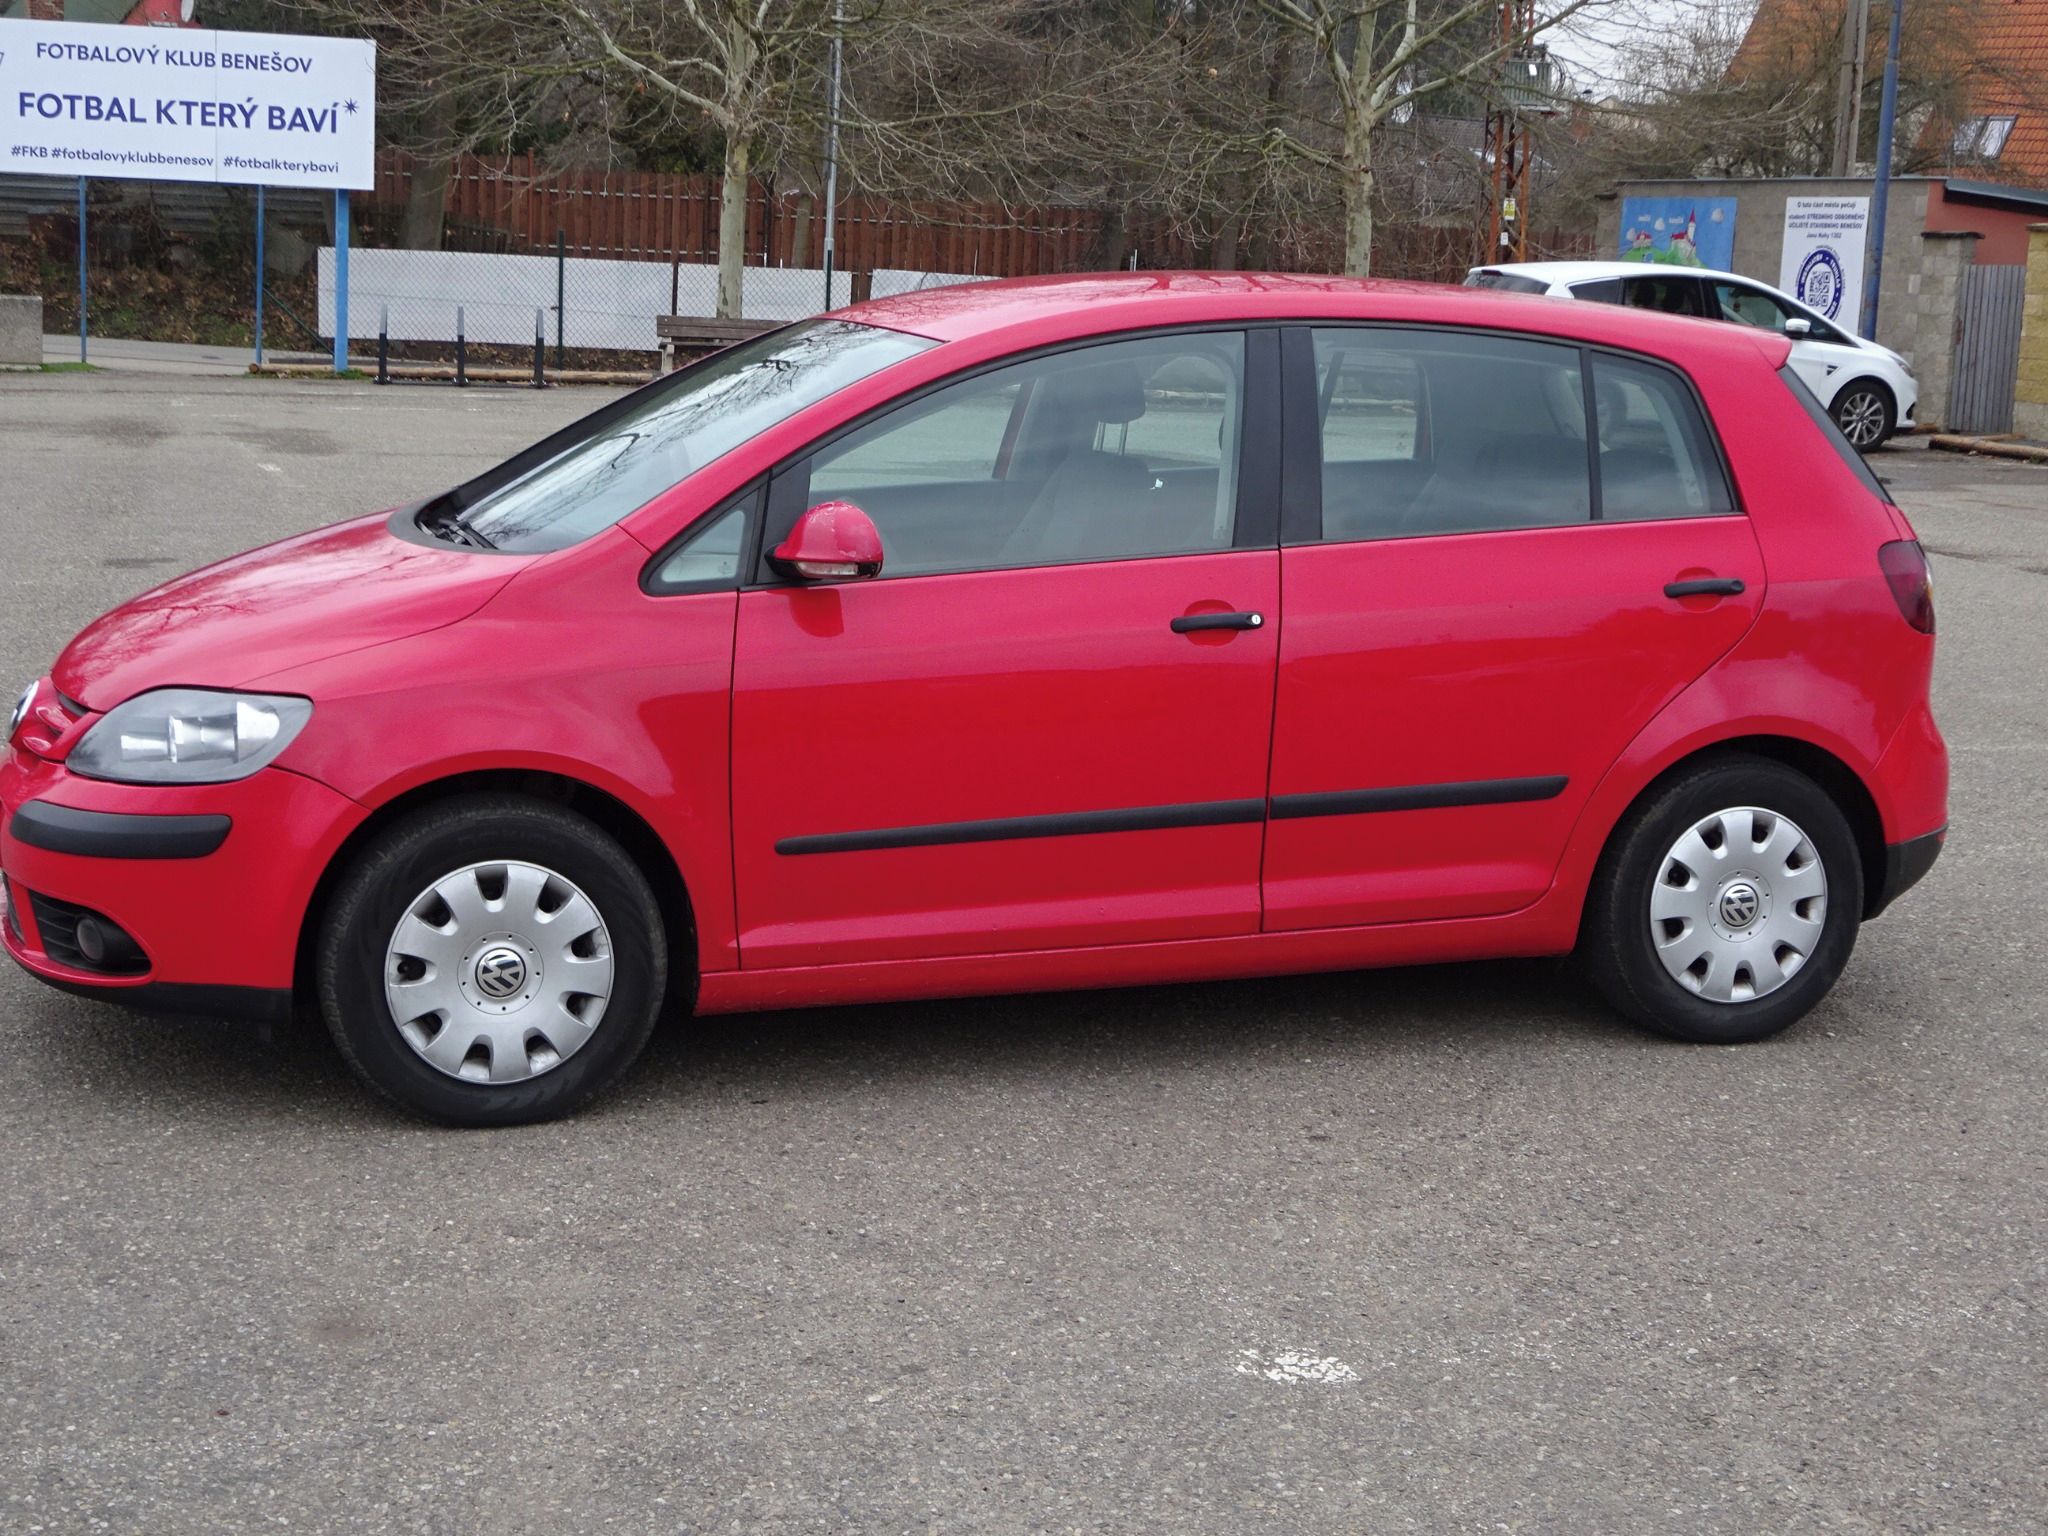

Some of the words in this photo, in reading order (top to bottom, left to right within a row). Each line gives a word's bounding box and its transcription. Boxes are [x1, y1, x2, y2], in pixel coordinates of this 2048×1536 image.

[36, 42, 160, 65] FOTBALOVÝ
[165, 50, 217, 68] KLUB
[221, 51, 313, 74] BENEŠOV
[19, 91, 147, 124] FOTBAL
[155, 98, 258, 129] KTERÝ
[268, 102, 338, 134] BAVÍ
[11, 145, 49, 159] #FKB
[51, 147, 215, 167] #fotbalovyklubbenesov
[223, 155, 340, 174] #fotbalkterybavi
